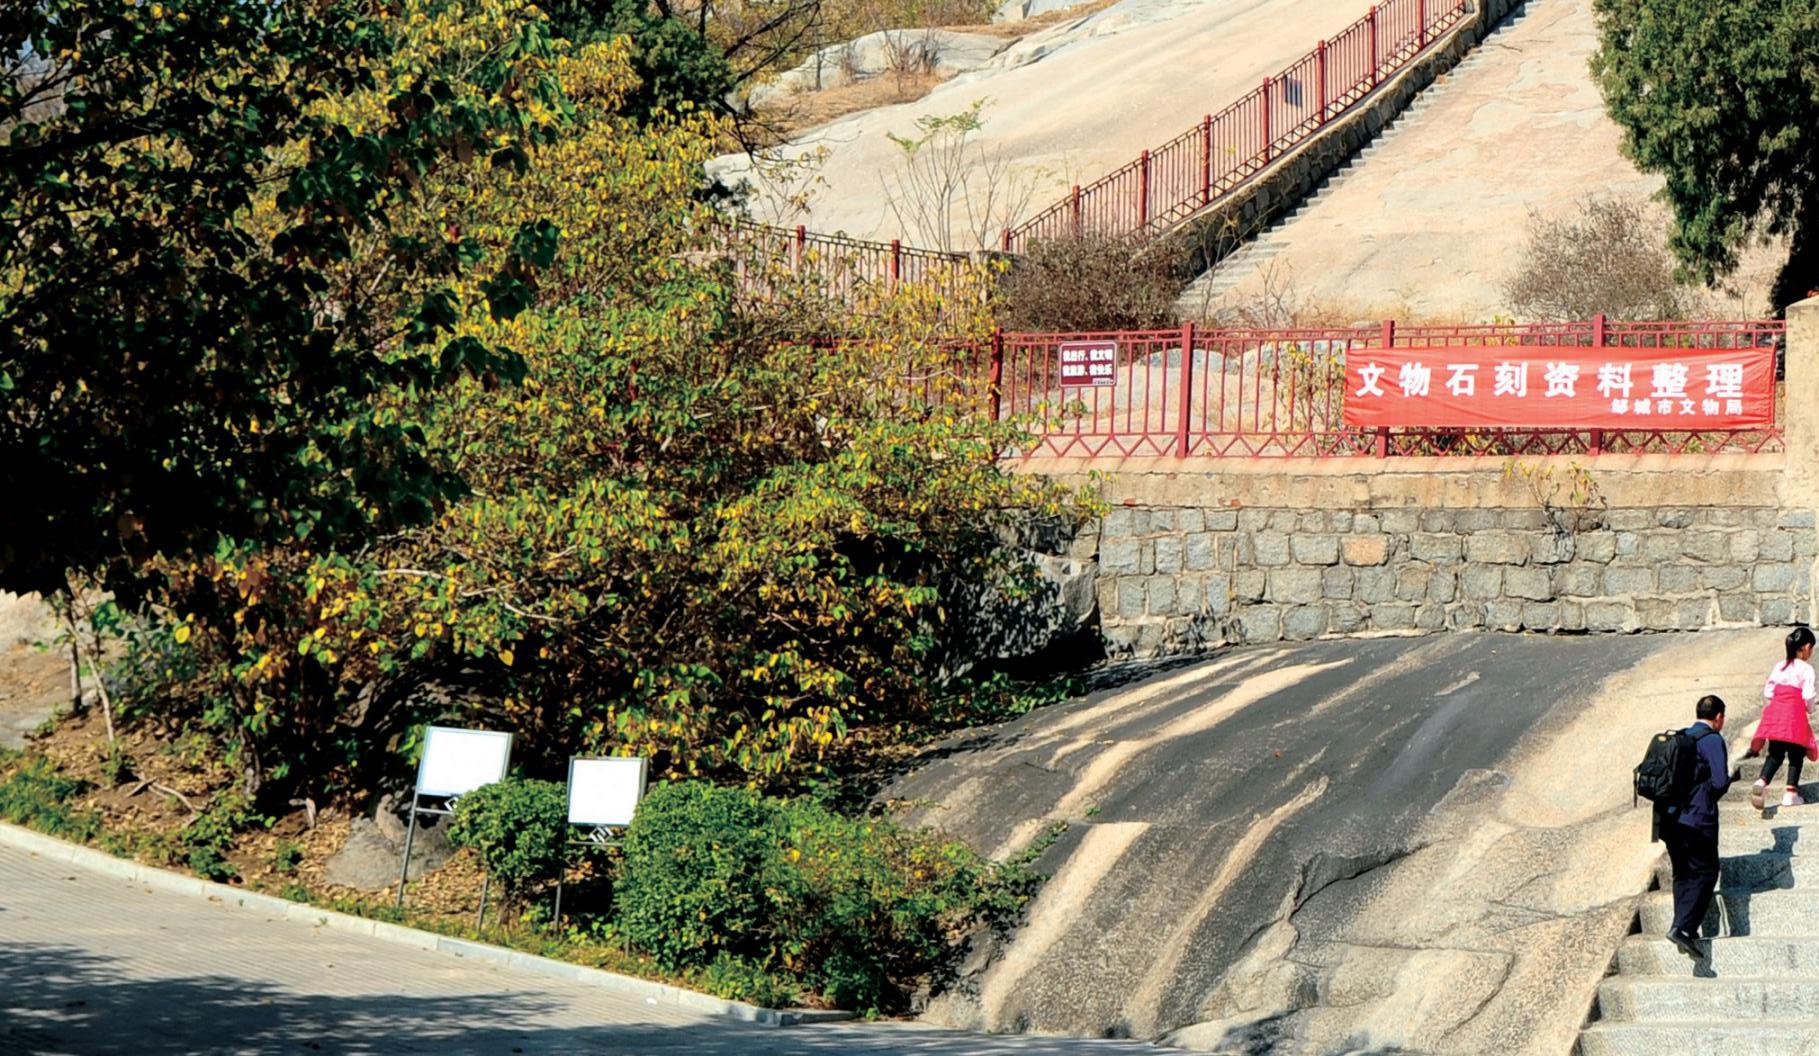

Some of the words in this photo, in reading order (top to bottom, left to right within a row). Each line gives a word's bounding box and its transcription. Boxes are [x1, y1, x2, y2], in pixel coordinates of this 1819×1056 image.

[1355, 362, 1744, 398] 文物石刻资料整理
